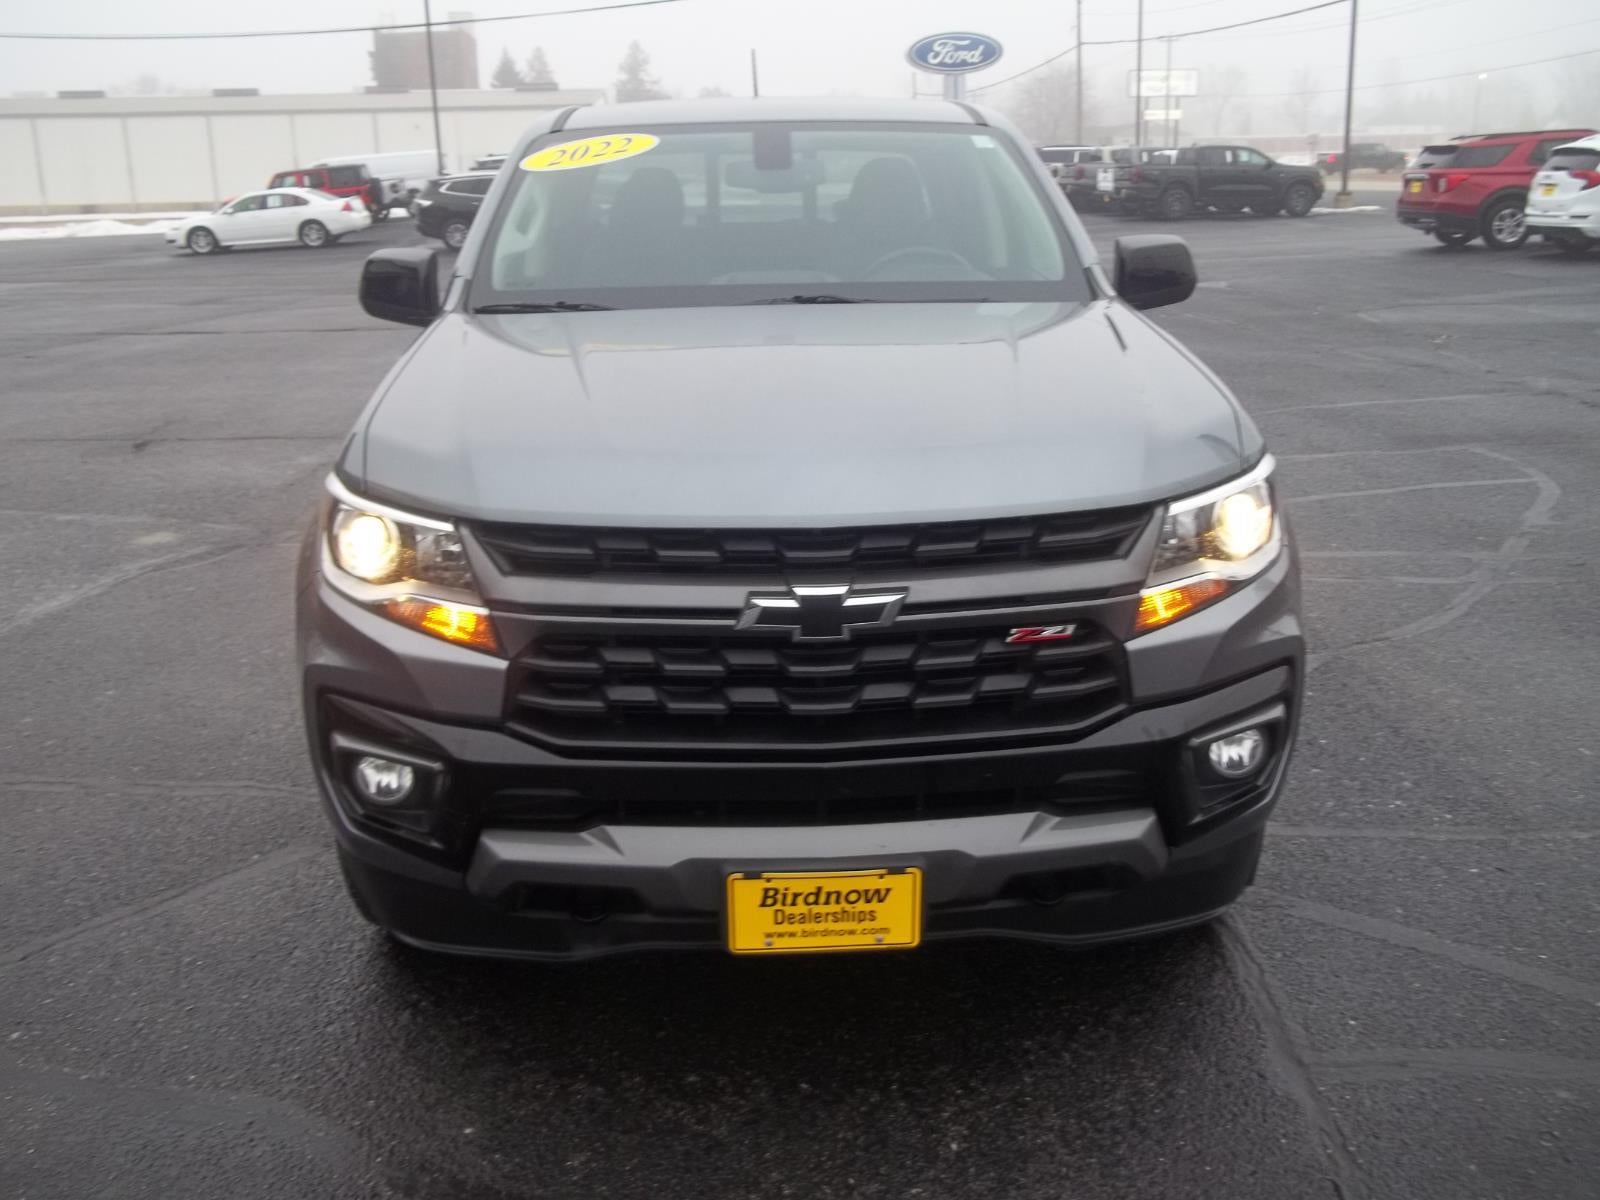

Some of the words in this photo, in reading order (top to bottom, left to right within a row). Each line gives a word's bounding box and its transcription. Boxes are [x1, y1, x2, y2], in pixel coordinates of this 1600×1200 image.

[927, 39, 984, 64] Ford
[547, 137, 632, 167] 2022
[1005, 624, 1077, 642] Z71
[758, 885, 893, 908] Birdnow
[773, 907, 877, 926] Dealerships
[764, 926, 890, 939] www.birdnow.com
